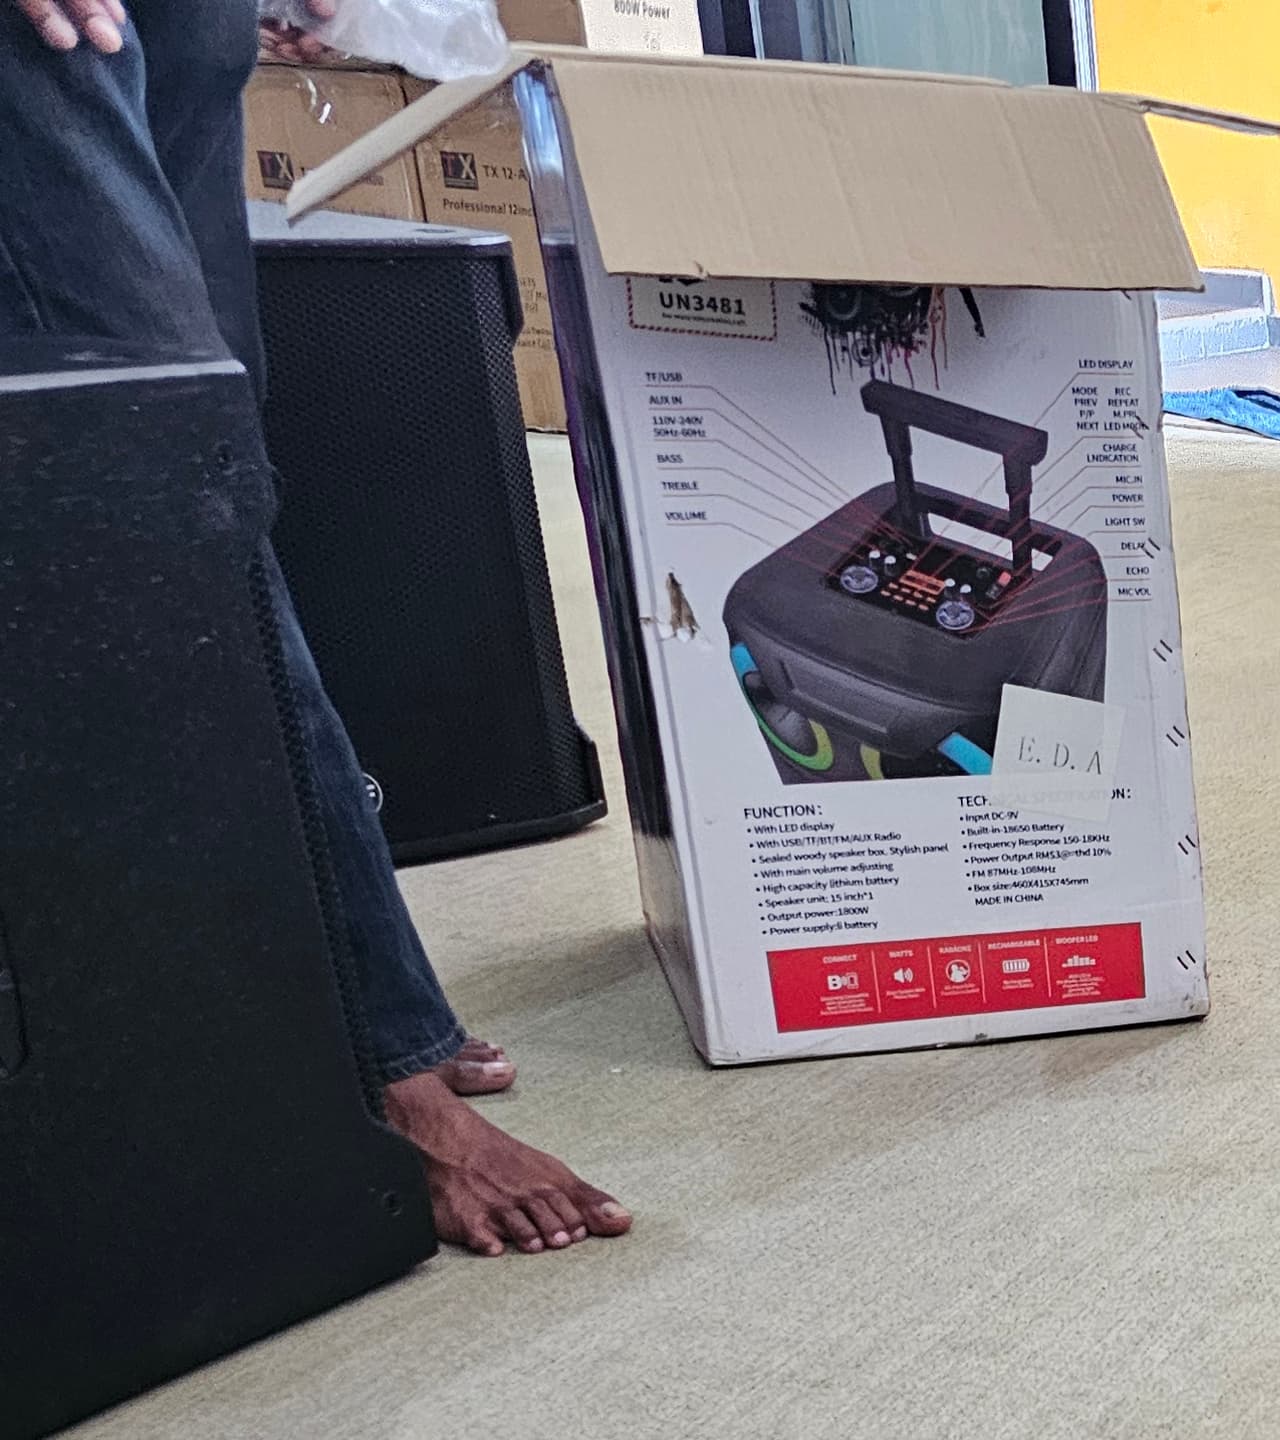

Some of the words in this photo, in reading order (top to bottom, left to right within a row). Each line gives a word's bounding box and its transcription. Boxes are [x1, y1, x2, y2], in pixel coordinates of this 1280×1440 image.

[483, 164, 500, 178] TX
[443, 198, 506, 215] Professional
[659, 291, 746, 316] UN3481
[1079, 359, 1096, 369] LED
[1098, 360, 1134, 369] DISPLAY
[645, 372, 683, 384] TF/USB
[1072, 387, 1098, 396] MODE
[1115, 387, 1131, 396] REC
[1074, 399, 1098, 407] PREV
[1108, 399, 1139, 407] REPEAT
[1077, 422, 1099, 431] NEXT
[1104, 422, 1121, 431] LED
[1103, 443, 1137, 452] CHARGE
[657, 454, 684, 464] BASS
[661, 481, 699, 491] TREBLE
[1112, 493, 1144, 502] POWER
[665, 511, 707, 521] VOLUME
[1105, 517, 1130, 526] LIGHT
[1121, 542, 1146, 550] DELAY
[1126, 567, 1150, 575] ECHO
[1118, 588, 1134, 596] MIC
[1134, 588, 1152, 596] VOL
[966, 813, 990, 824] Input
[754, 825, 777, 835] With
[779, 823, 799, 833] LED
[800, 821, 835, 832] display
[1031, 823, 1065, 835] Battery
[757, 839, 780, 849] With
[874, 832, 902, 841] Radio
[969, 839, 1017, 851] Frequency
[1018, 837, 1061, 849] Response
[759, 853, 792, 864] Sealed
[794, 851, 827, 863] woody
[829, 847, 866, 860] speaker
[889, 845, 921, 858] Stylish
[923, 843, 949, 854] panel
[971, 855, 999, 865] Power
[1001, 852, 1034, 863] Output
[761, 869, 784, 879] With
[786, 867, 810, 877] main
[813, 865, 848, 875] volume
[850, 861, 894, 874] adjusting
[972, 869, 985, 878] FM
[763, 884, 786, 895] High
[788, 880, 828, 893] capacity
[829, 878, 863, 889] lithium
[865, 876, 900, 888] battery
[974, 883, 990, 893] Box
[765, 897, 805, 909] Speaker
[831, 893, 842, 902] 15
[975, 896, 1001, 906] MADE
[1003, 895, 1013, 904] IN
[1015, 893, 1043, 903] CHINA
[768, 911, 802, 923] Output
[770, 926, 801, 936] Power
[844, 920, 878, 931] battery
